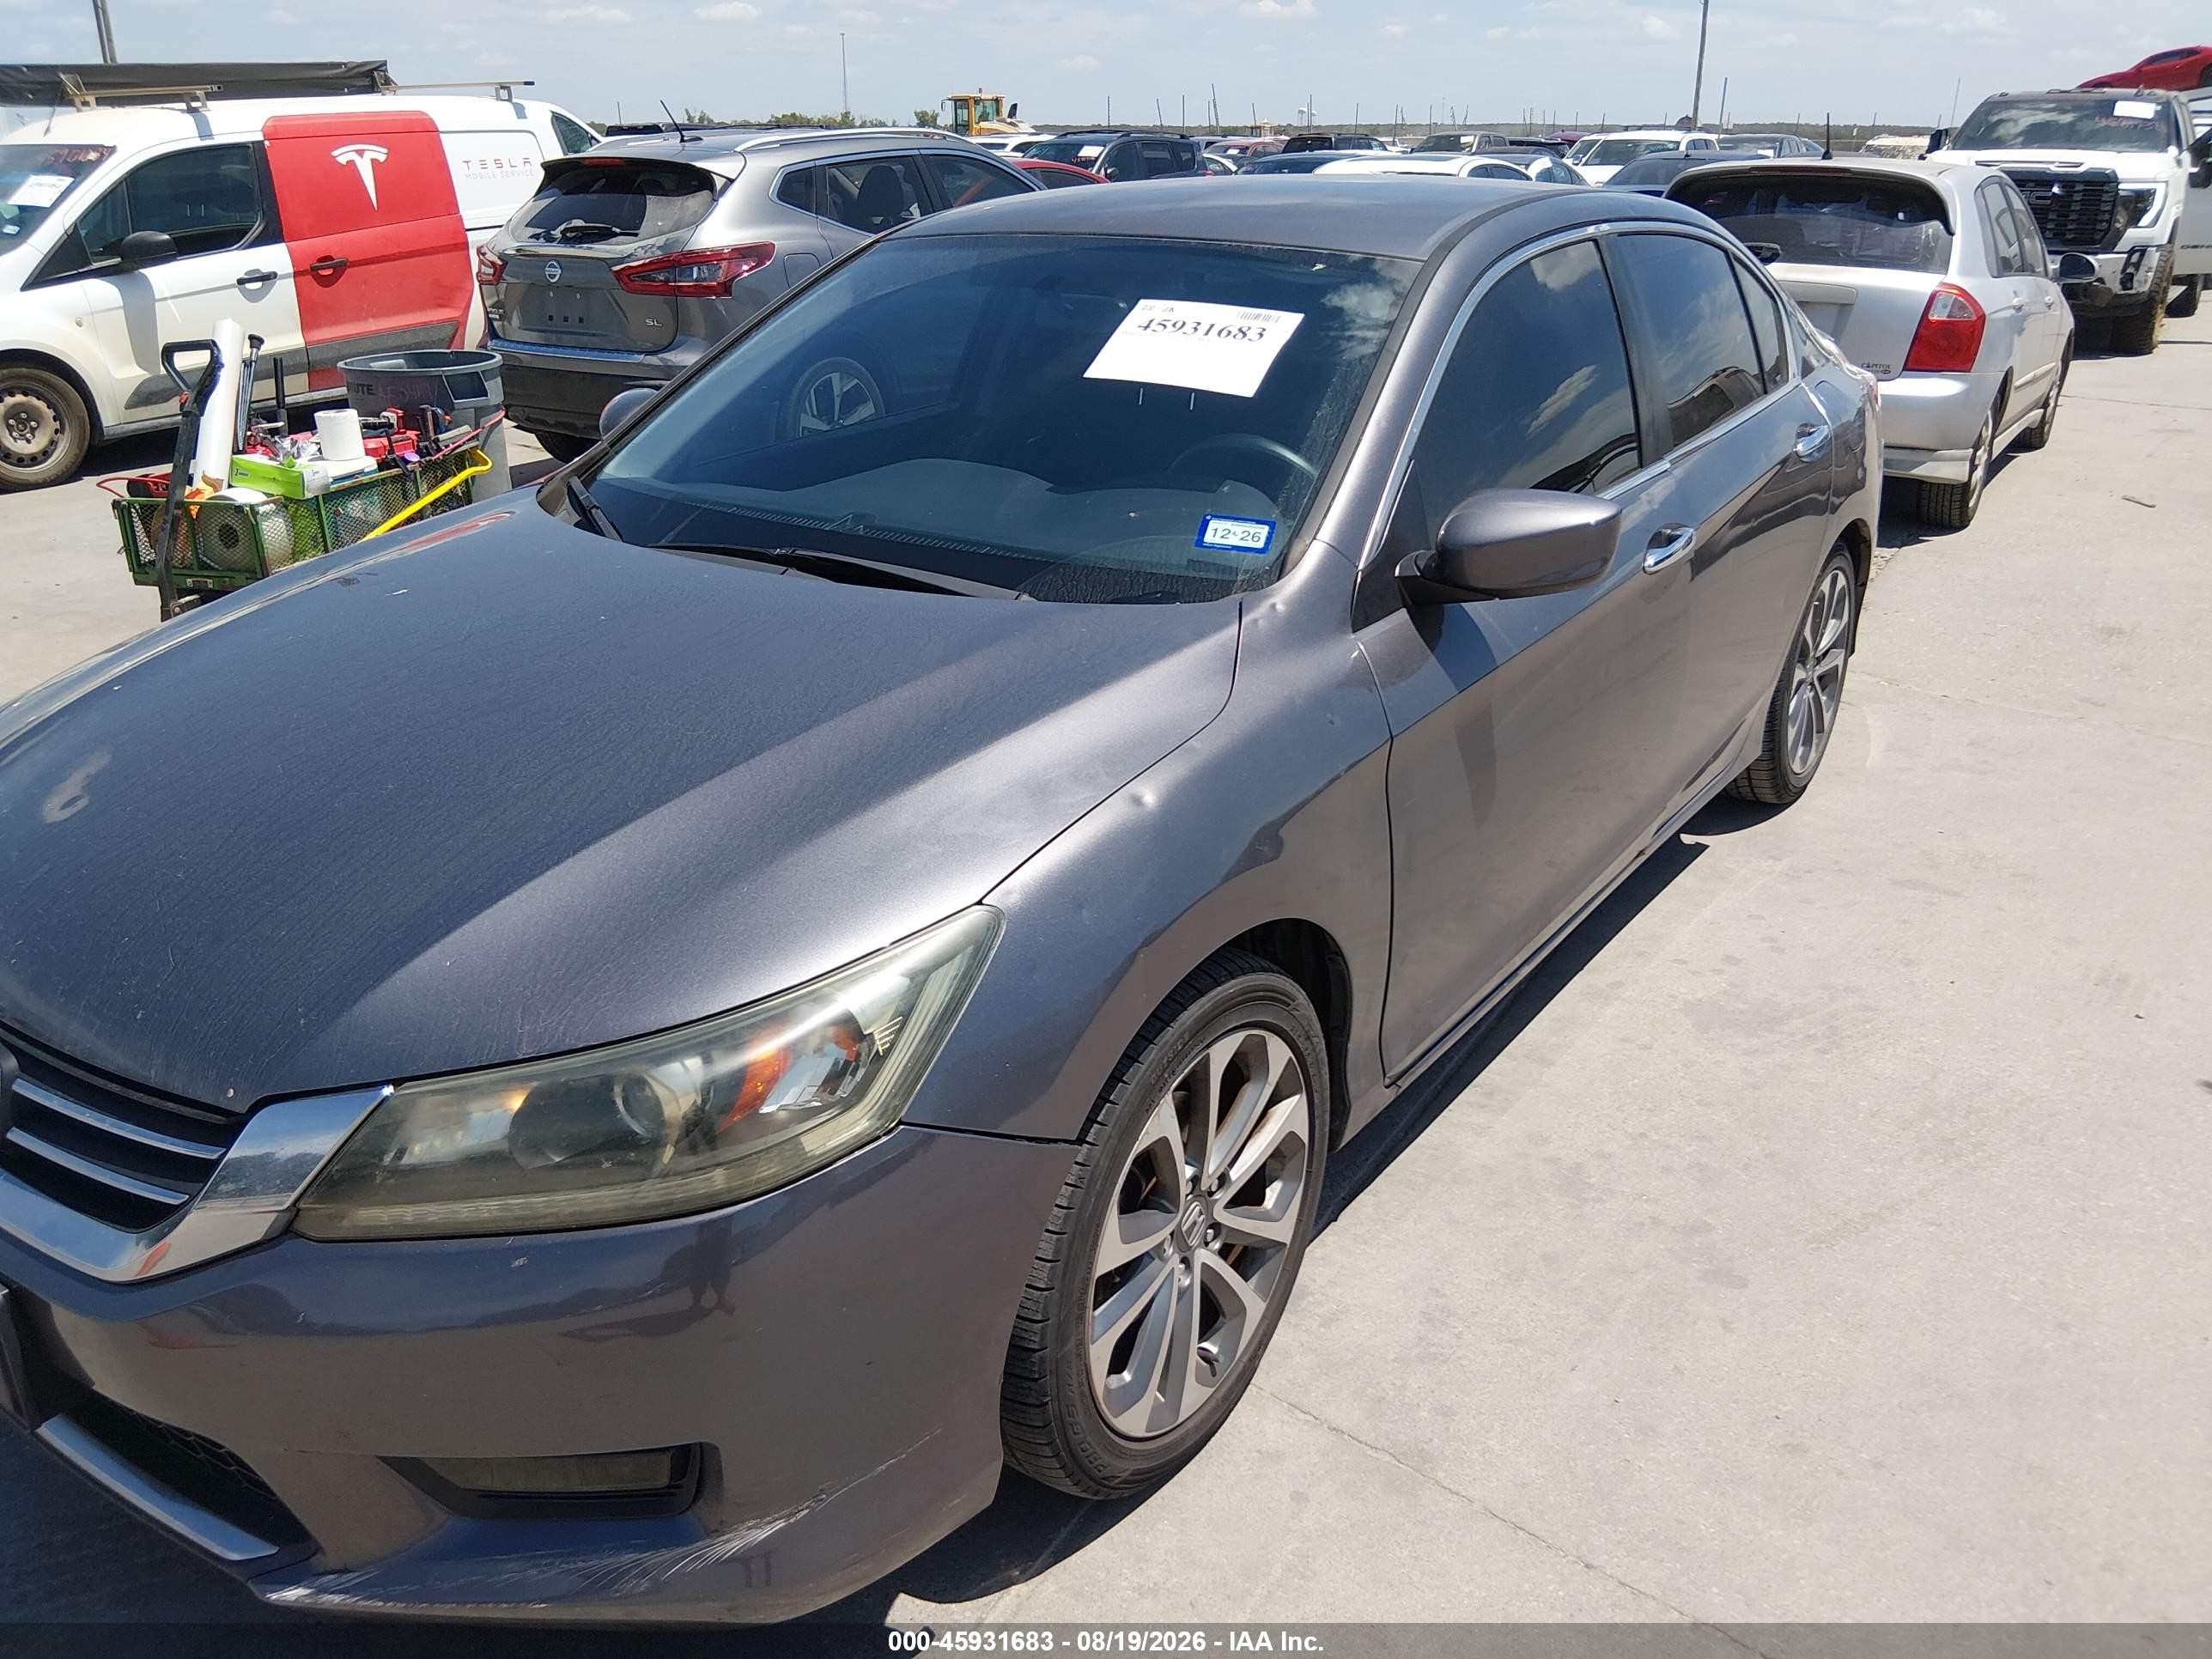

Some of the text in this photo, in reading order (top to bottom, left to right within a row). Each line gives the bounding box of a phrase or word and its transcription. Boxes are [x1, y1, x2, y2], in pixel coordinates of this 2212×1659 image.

[462, 157, 532, 171] TESLA
[465, 169, 536, 180] MOBILE SERVICE
[645, 319, 663, 327] SL
[1138, 318, 1267, 342] 45931683
